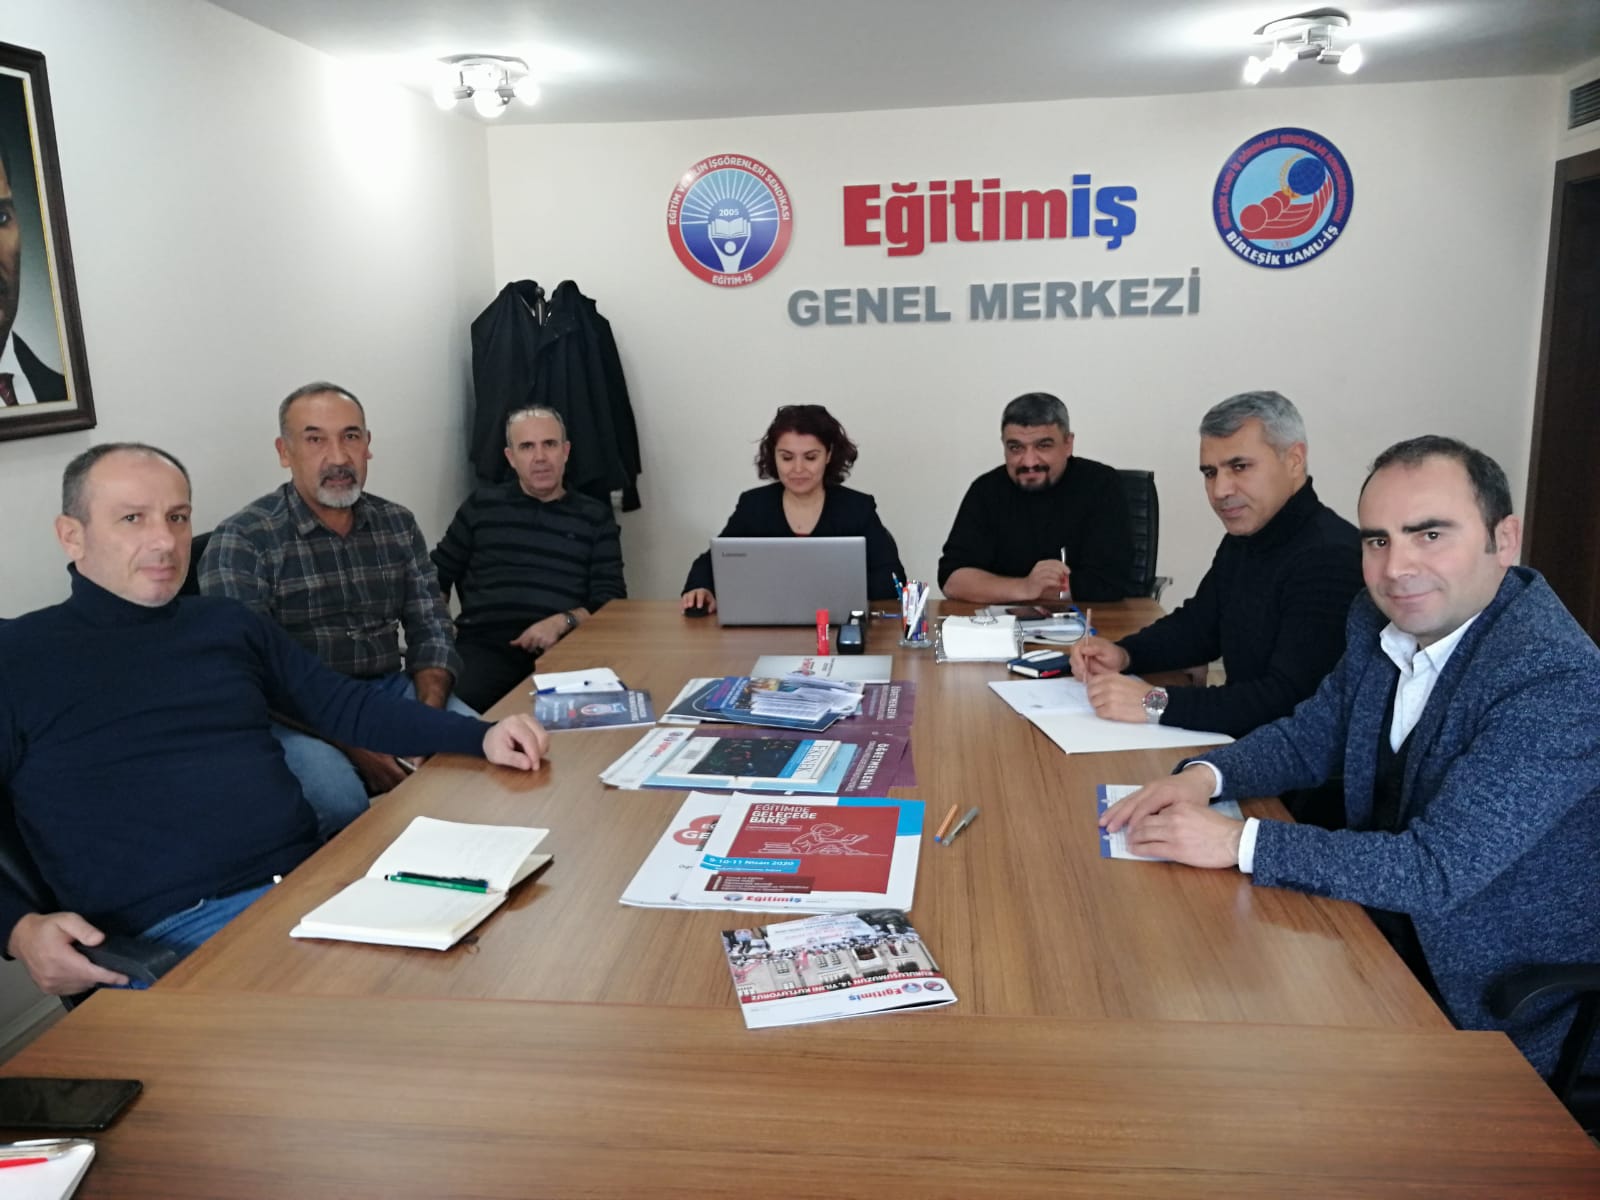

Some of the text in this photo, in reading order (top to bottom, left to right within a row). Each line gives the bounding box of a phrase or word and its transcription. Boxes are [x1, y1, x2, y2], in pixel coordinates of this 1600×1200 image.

[668, 193, 682, 225] EĞİTİM
[765, 175, 790, 220] SENDİKASI
[719, 208, 739, 217] 2005
[843, 174, 1137, 256] Eğitimiş
[1226, 225, 1339, 265] BİRLEŞİK KAMU-İŞ
[712, 273, 753, 285] EĞİTİM-İŞ
[787, 267, 1201, 326] GENEL MERKEZİ
[755, 803, 811, 813] EĞİTİMDE
[749, 817, 788, 826] BAKIŞ
[752, 811, 817, 820] GELECEĞE
[751, 987, 811, 1000] KUTLUYORUZ
